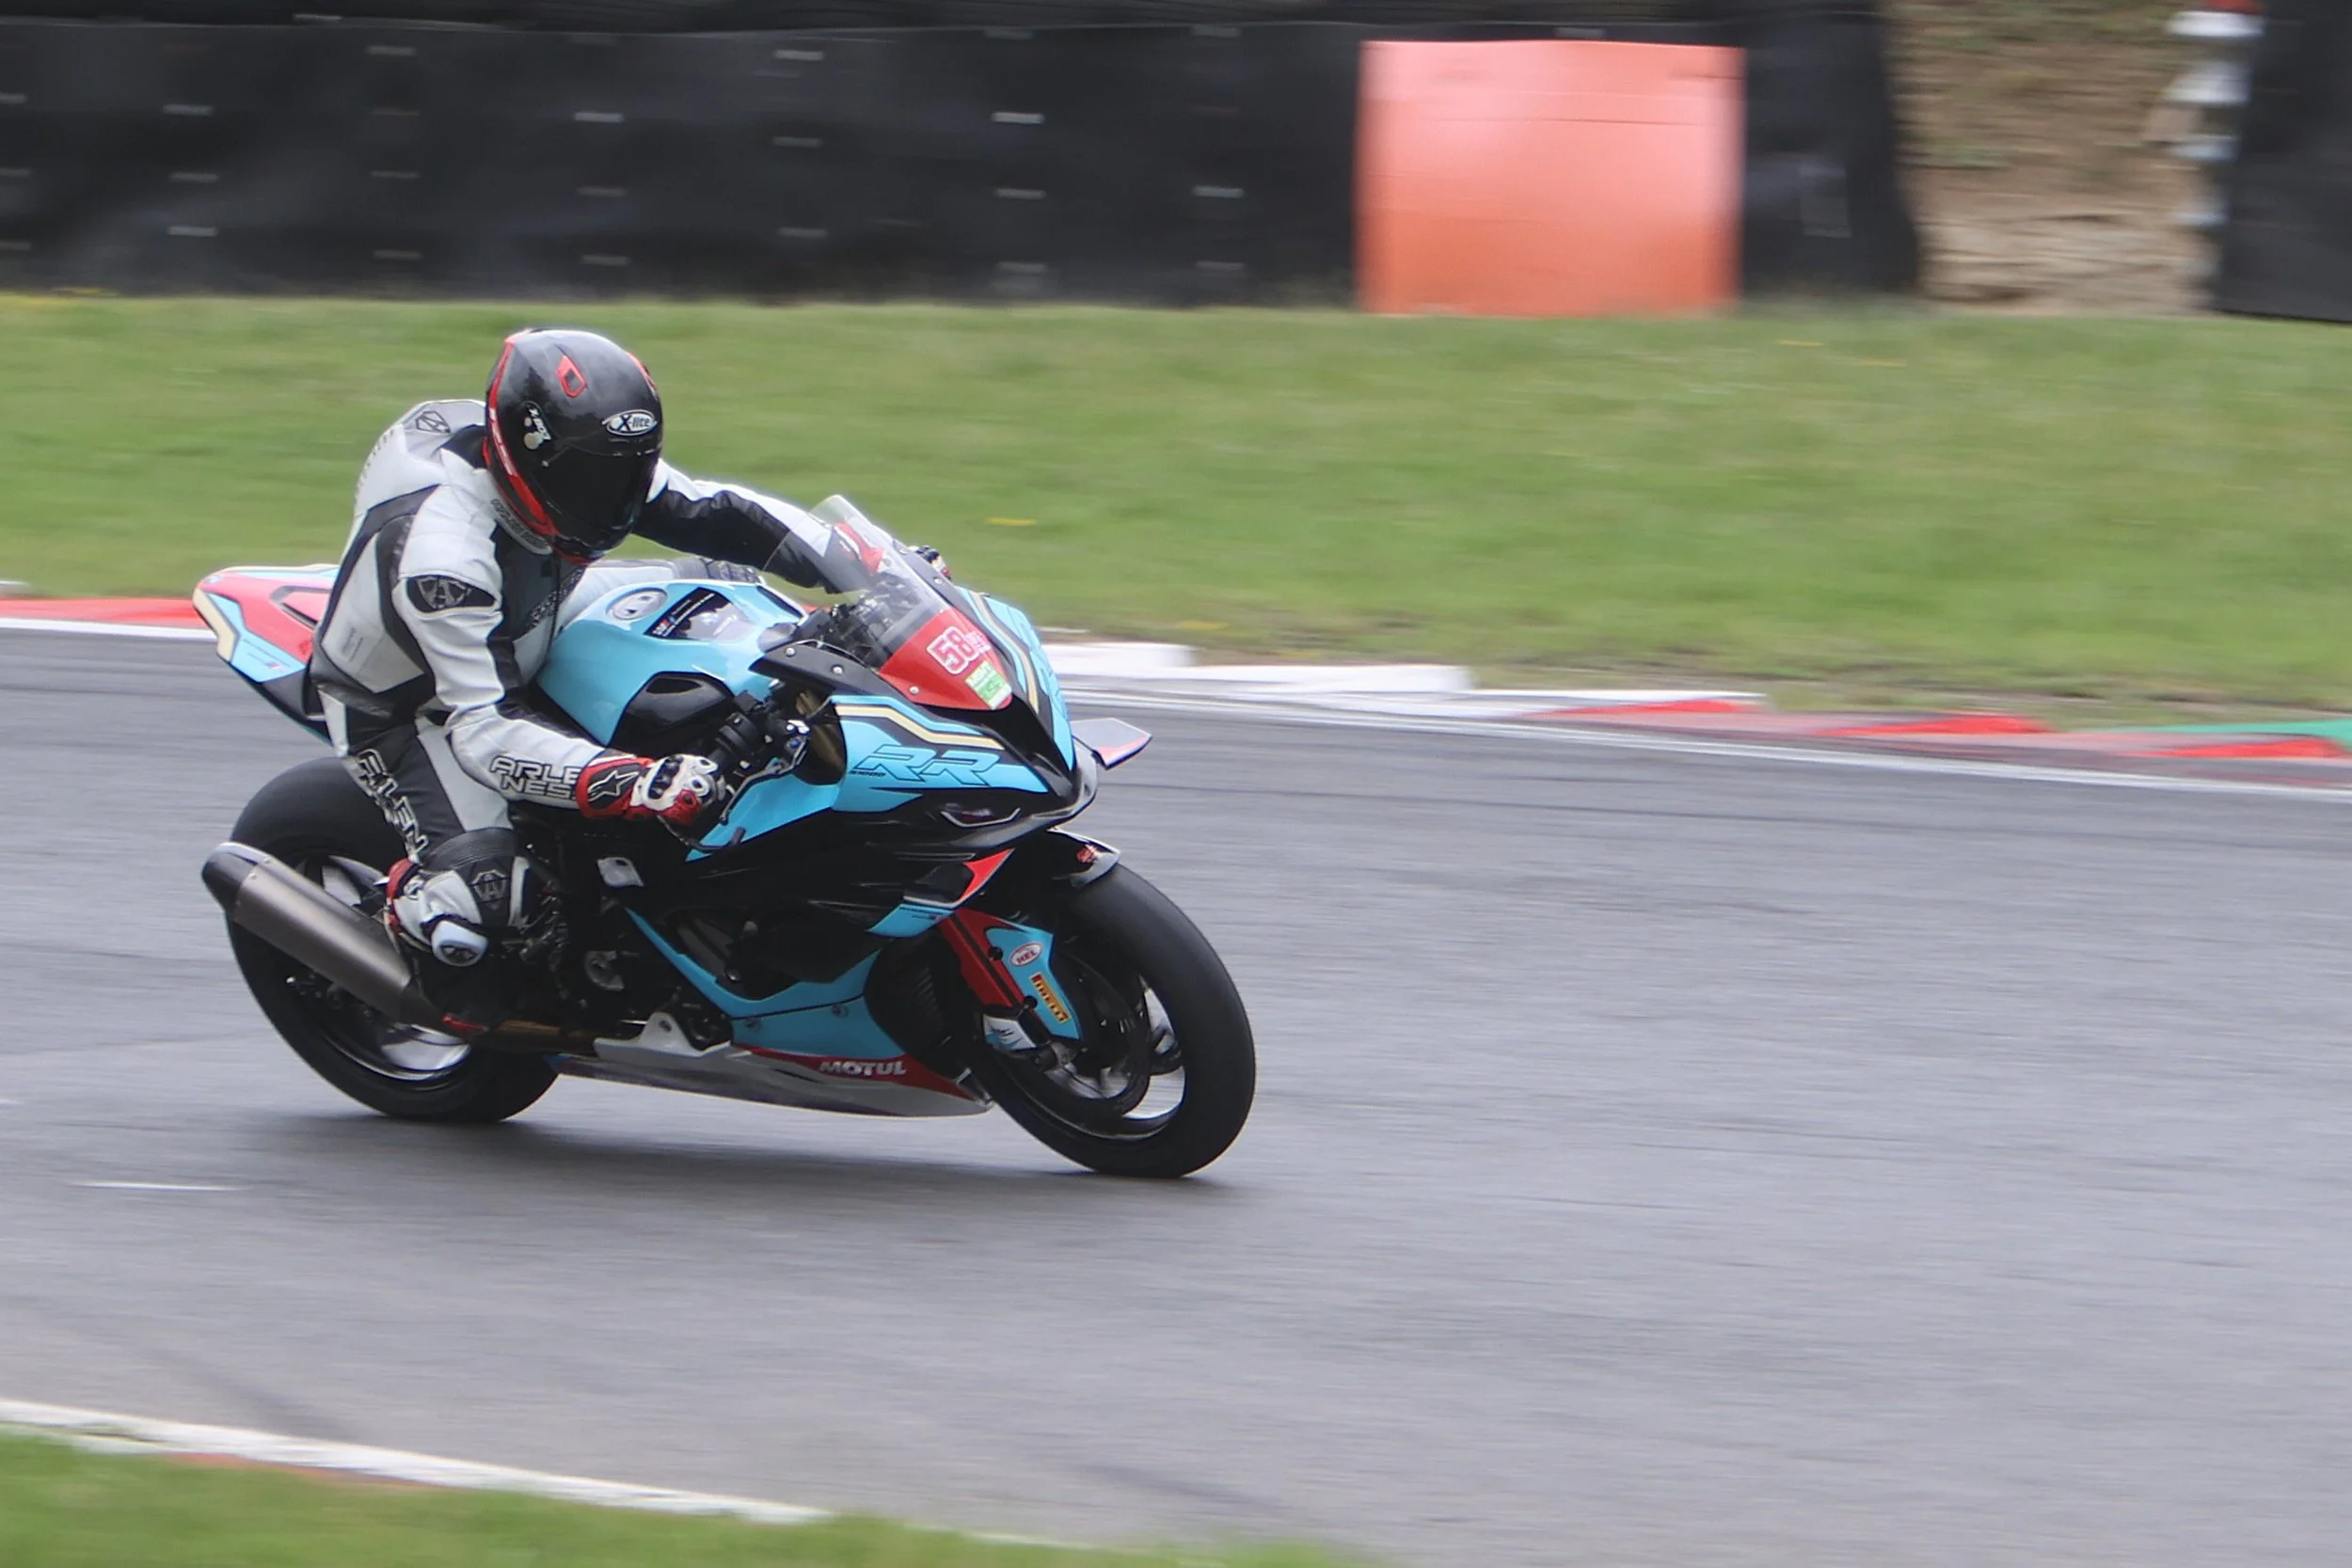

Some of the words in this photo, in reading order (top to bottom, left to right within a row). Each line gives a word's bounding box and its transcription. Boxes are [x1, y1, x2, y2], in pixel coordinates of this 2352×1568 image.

[617, 414, 650, 431] X-lite
[927, 626, 980, 675] 58
[853, 743, 1001, 787] RR
[501, 774, 577, 800] NES
[1016, 949, 1038, 964] HEL
[1030, 971, 1071, 1023] PIRELLI
[819, 1060, 907, 1076] MOTUL
